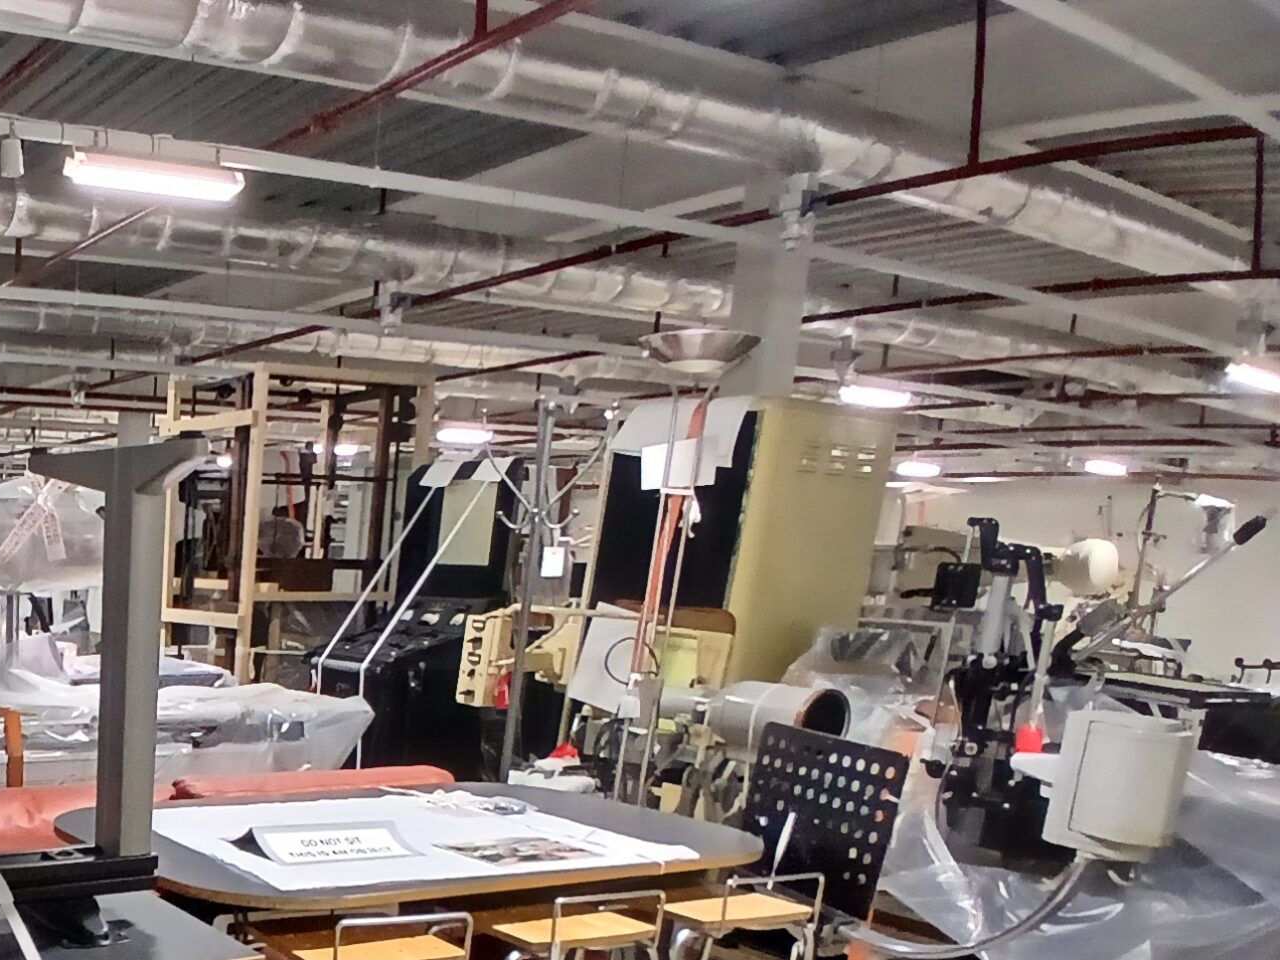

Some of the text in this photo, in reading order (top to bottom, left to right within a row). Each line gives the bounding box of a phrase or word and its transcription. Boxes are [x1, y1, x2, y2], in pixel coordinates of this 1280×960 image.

[300, 836, 362, 848] DO NOT SIT
[317, 849, 330, 857] IS
